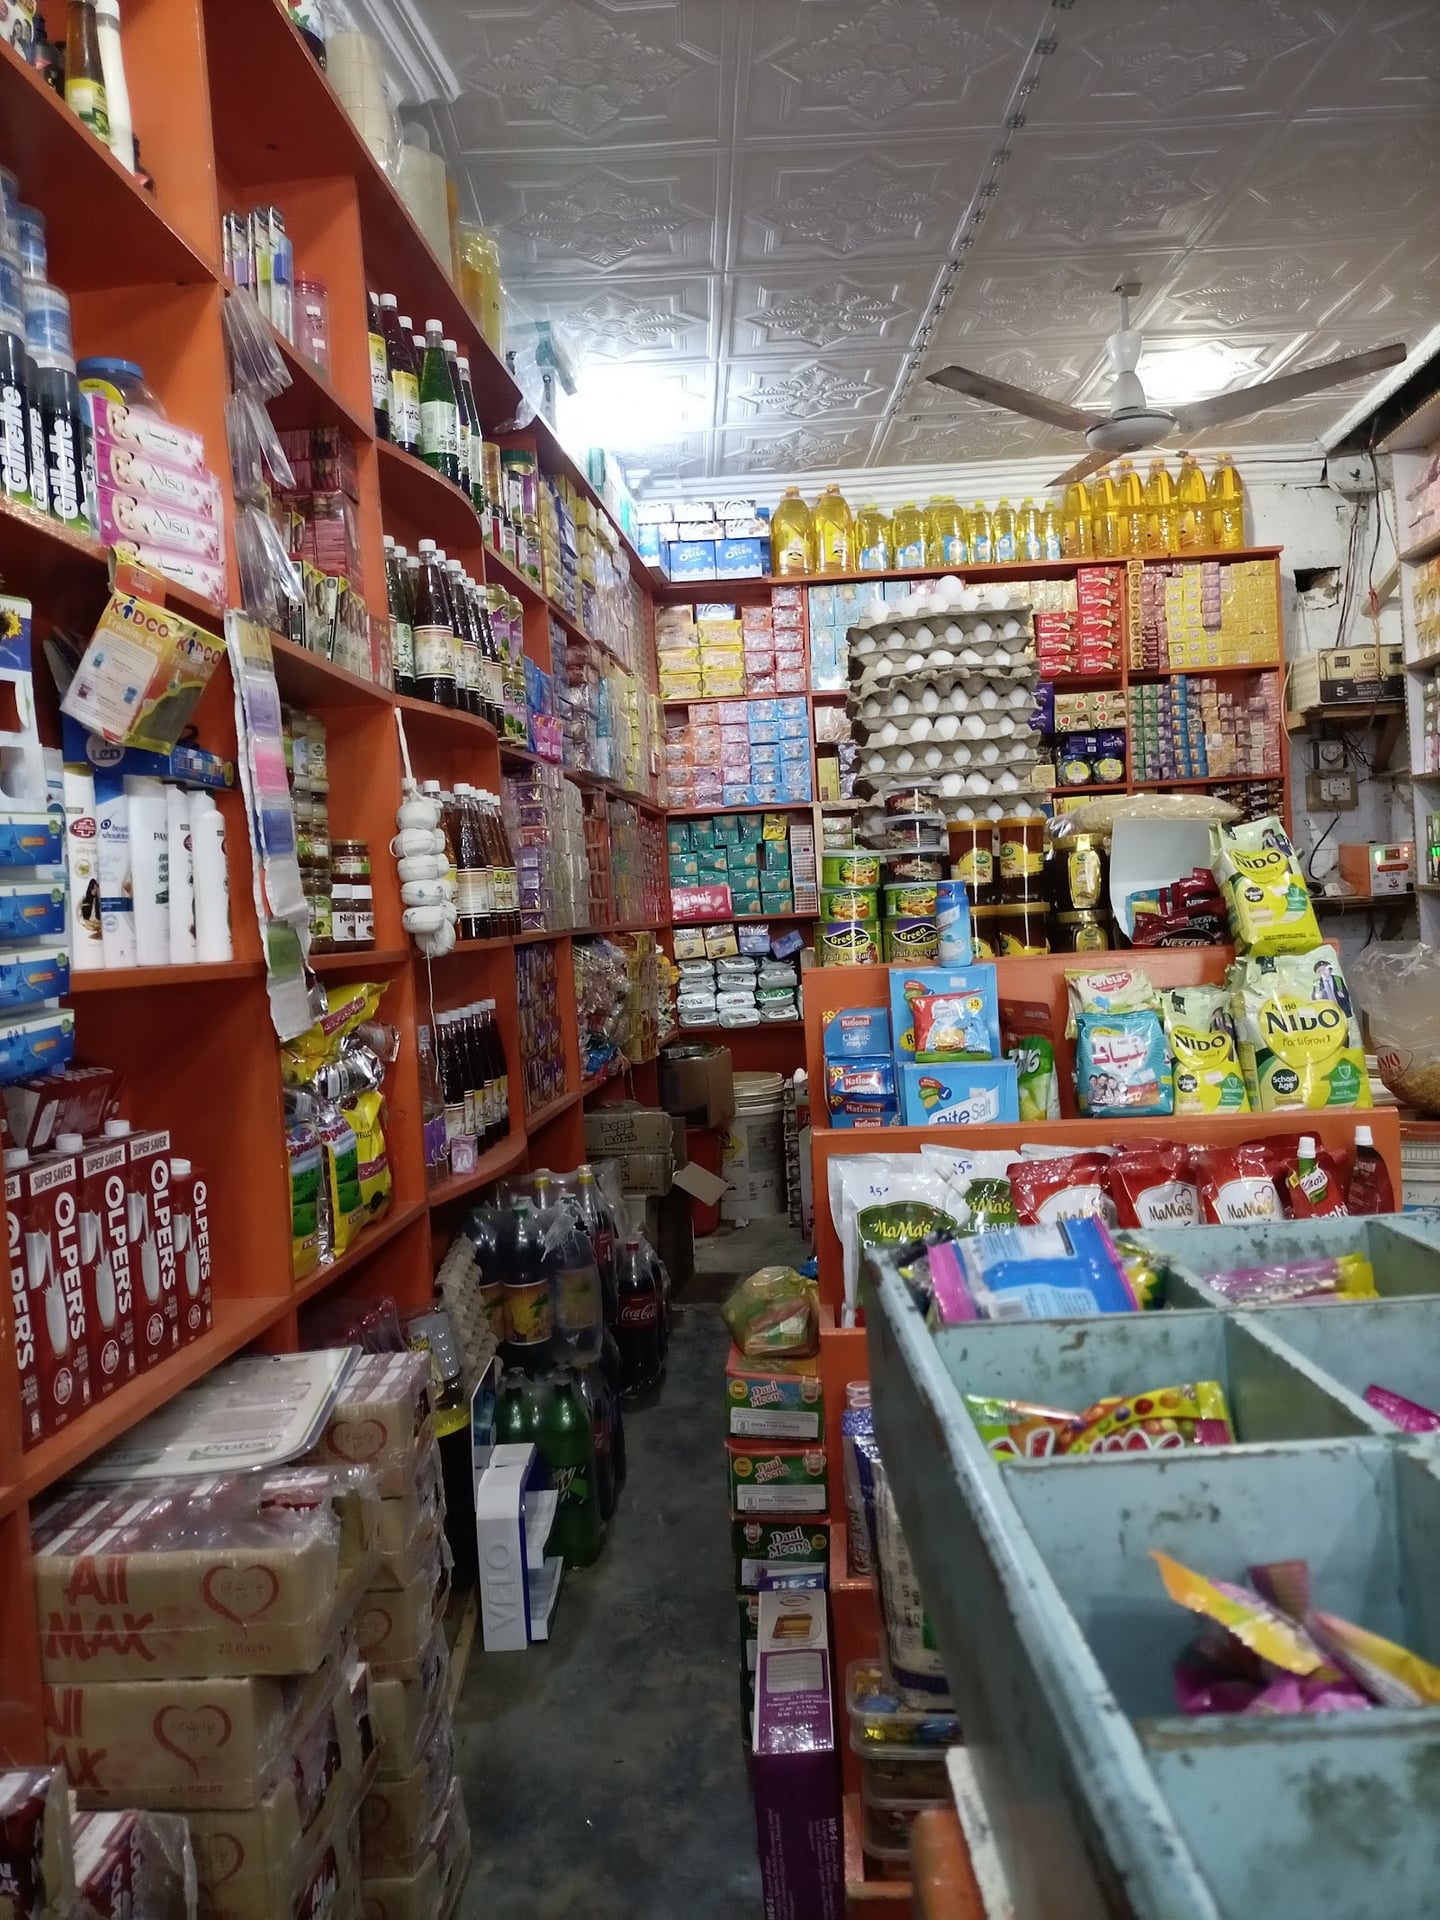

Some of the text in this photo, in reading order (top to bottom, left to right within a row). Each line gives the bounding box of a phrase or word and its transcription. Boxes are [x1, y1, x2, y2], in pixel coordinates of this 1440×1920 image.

[150, 465, 186, 492] Nisa
[153, 509, 190, 535] Nisa
[1235, 852, 1281, 869] NIDO
[900, 927, 926, 940] Green
[841, 1018, 870, 1027] National
[1265, 1008, 1339, 1034] NIDO
[1175, 1034, 1226, 1051] NIDO
[1273, 1075, 1298, 1083] School
[1278, 1082, 1294, 1091] Age
[971, 1100, 992, 1120] Salt
[855, 1119, 881, 1128] National
[133, 1134, 168, 1156] SUPER SAVER
[86, 1151, 122, 1173] SUPER SAVER
[34, 1164, 72, 1190] SUPER SAVER
[969, 1198, 1011, 1214] aMa's
[752, 1381, 778, 1397] Daal
[751, 1390, 785, 1407] Moong
[756, 1456, 783, 1472] Daal
[755, 1465, 790, 1483] Moong
[772, 1525, 803, 1543] Daal
[769, 1540, 811, 1559] Moong
[772, 1578, 817, 1590] H&S
[46, 1612, 156, 1662] MAX
